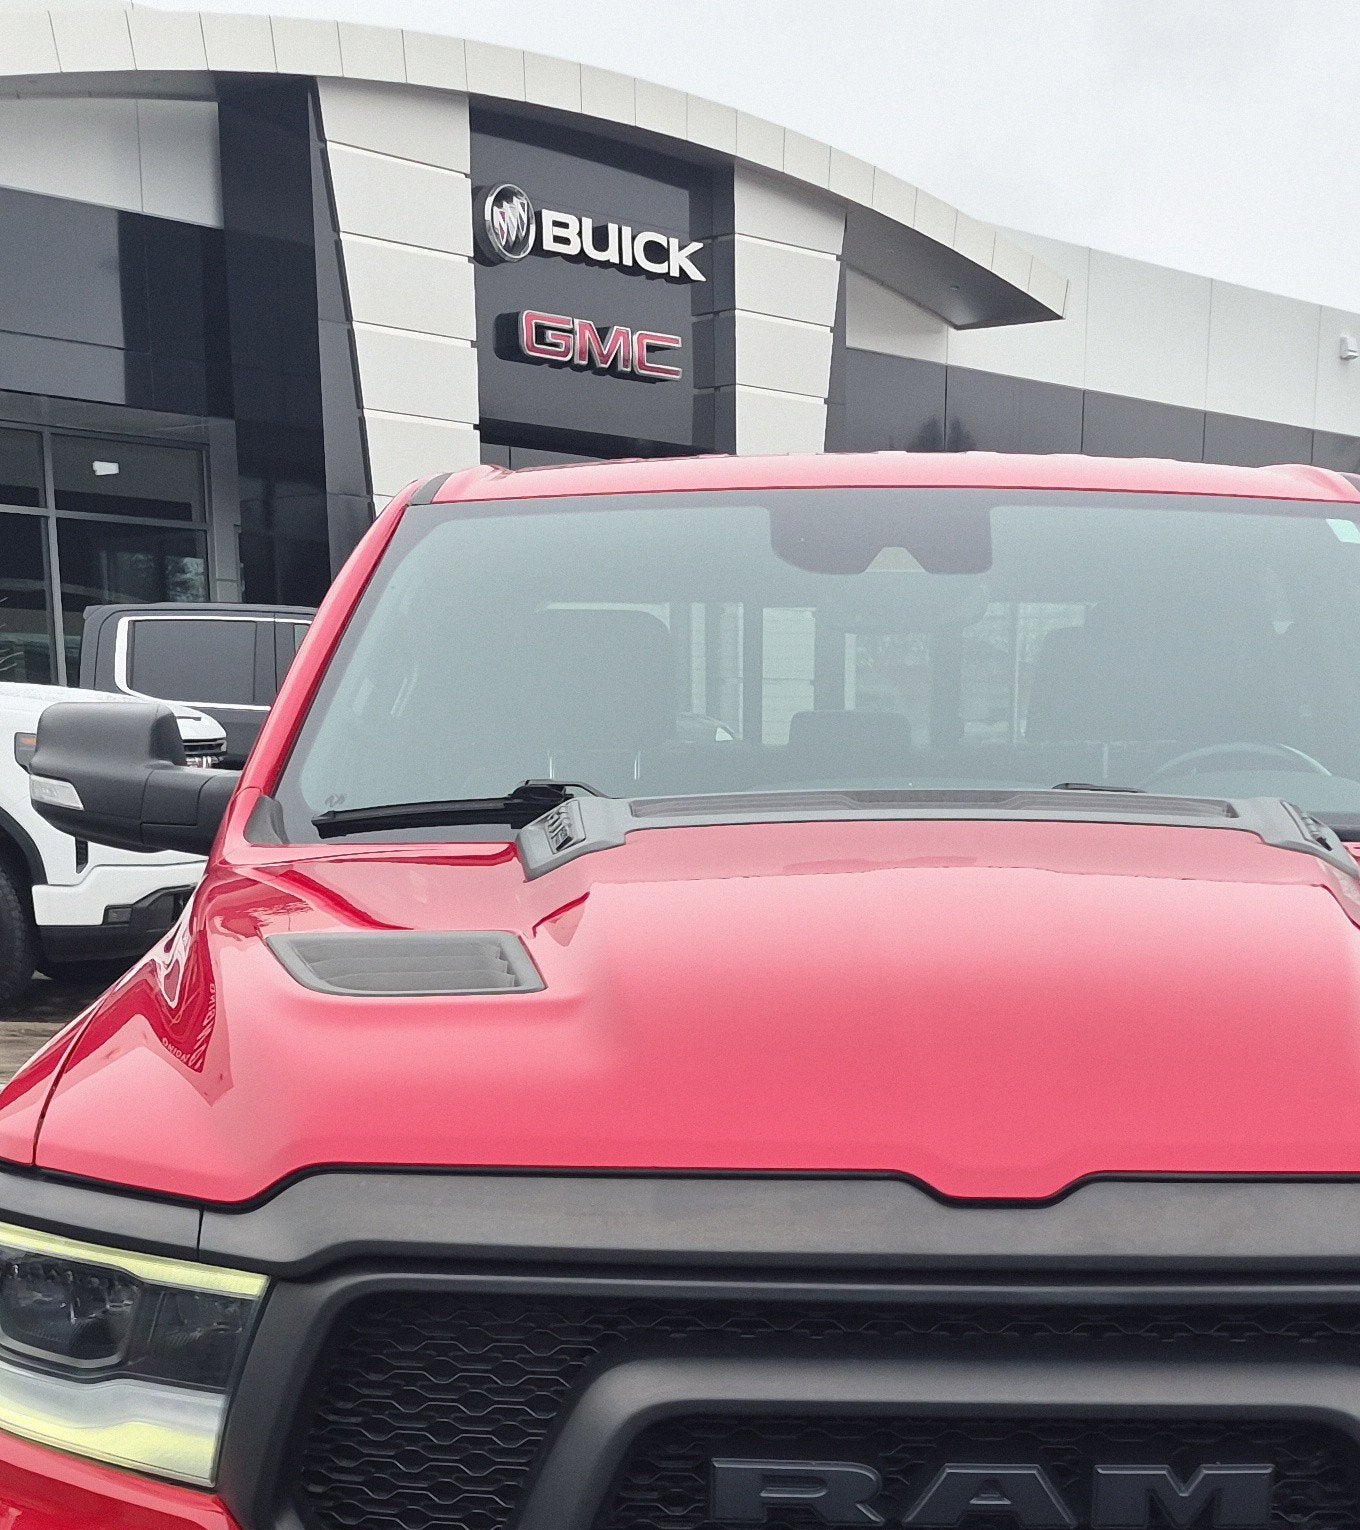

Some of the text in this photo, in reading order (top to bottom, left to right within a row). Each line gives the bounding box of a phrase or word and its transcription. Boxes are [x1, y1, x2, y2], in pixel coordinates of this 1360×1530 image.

[542, 208, 707, 282] BUICK
[519, 309, 683, 380] GMC
[711, 1458, 1274, 1529] RAM
